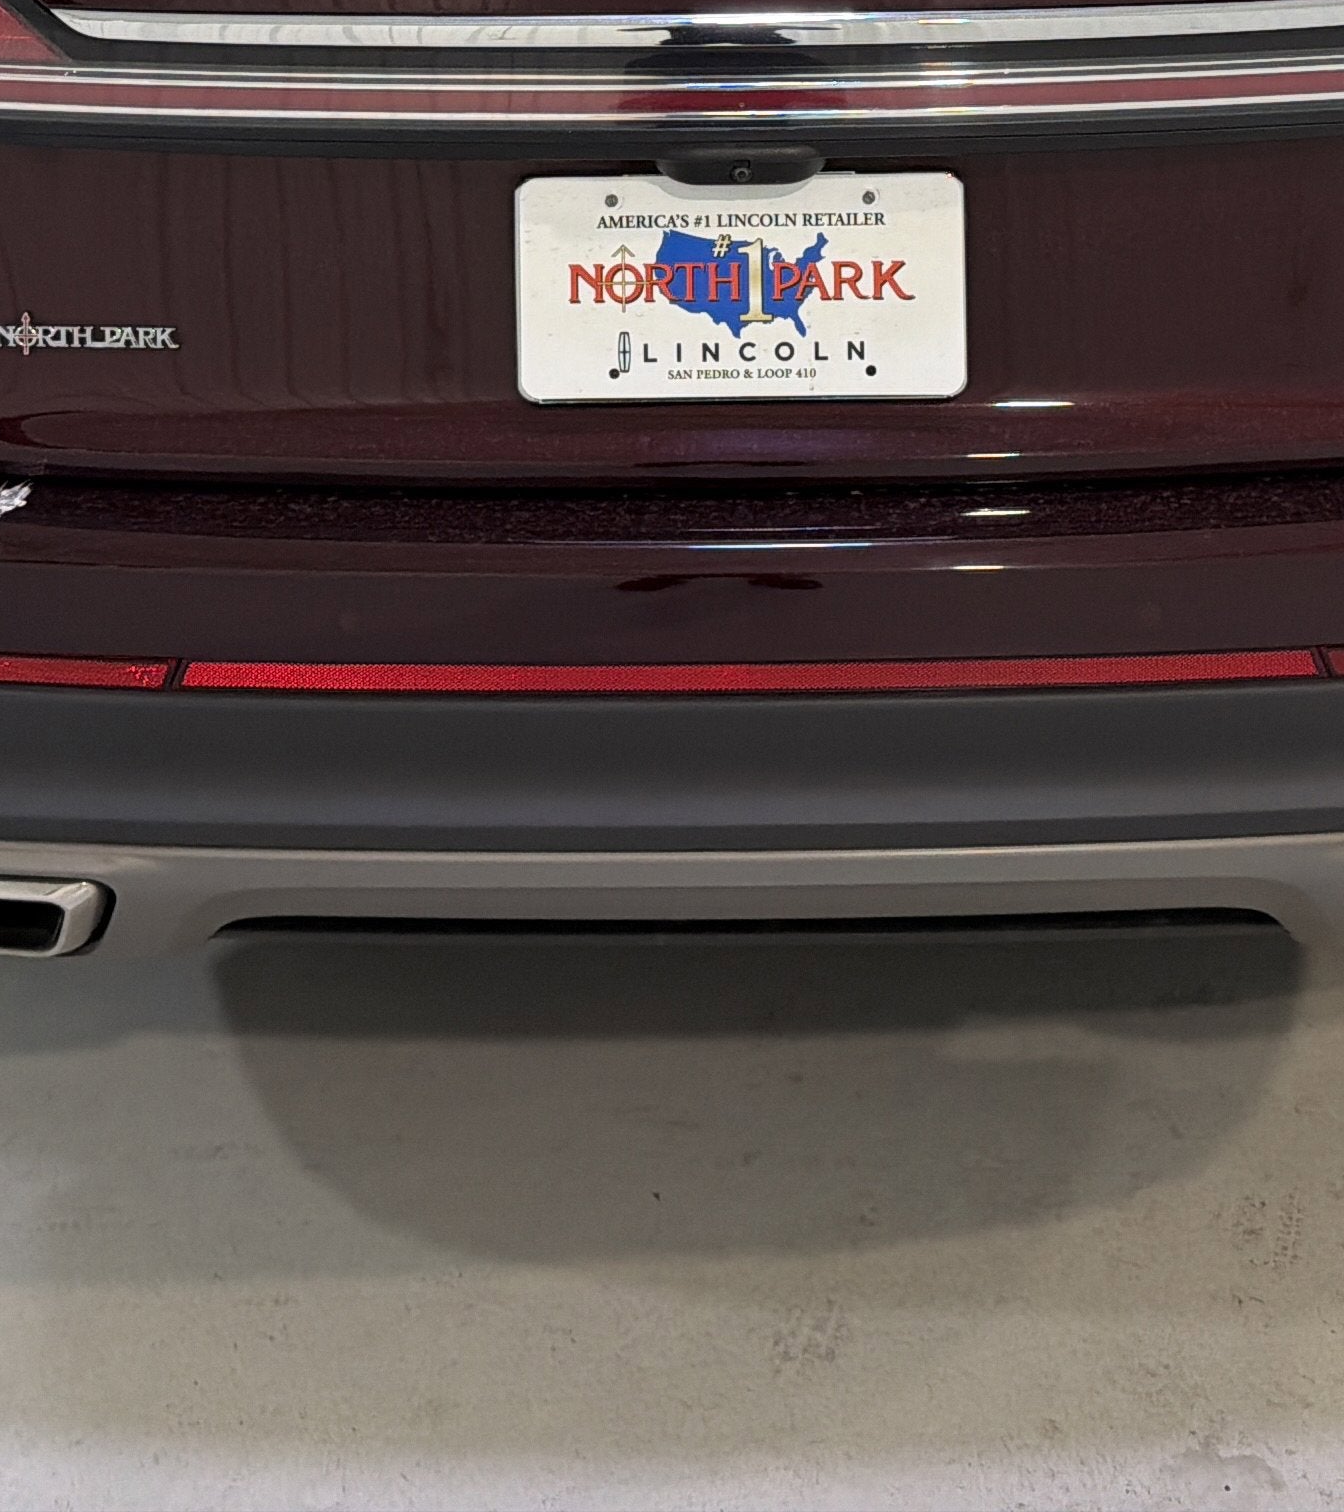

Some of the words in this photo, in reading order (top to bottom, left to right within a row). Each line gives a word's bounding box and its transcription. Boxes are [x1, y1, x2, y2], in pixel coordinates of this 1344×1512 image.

[596, 214, 690, 229] AMERICA'S
[693, 214, 712, 228] #1
[716, 213, 798, 228] LINCOLN
[801, 212, 887, 227] RETAILER
[567, 260, 743, 305] NORTH
[771, 259, 917, 302] PARK
[98, 326, 181, 349] PARK
[642, 340, 865, 364] LINCOLN
[667, 369, 693, 380] SAN
[696, 368, 741, 380] PEDRO
[743, 368, 754, 379] &
[757, 368, 793, 379] LOOP
[795, 367, 817, 379] 410
